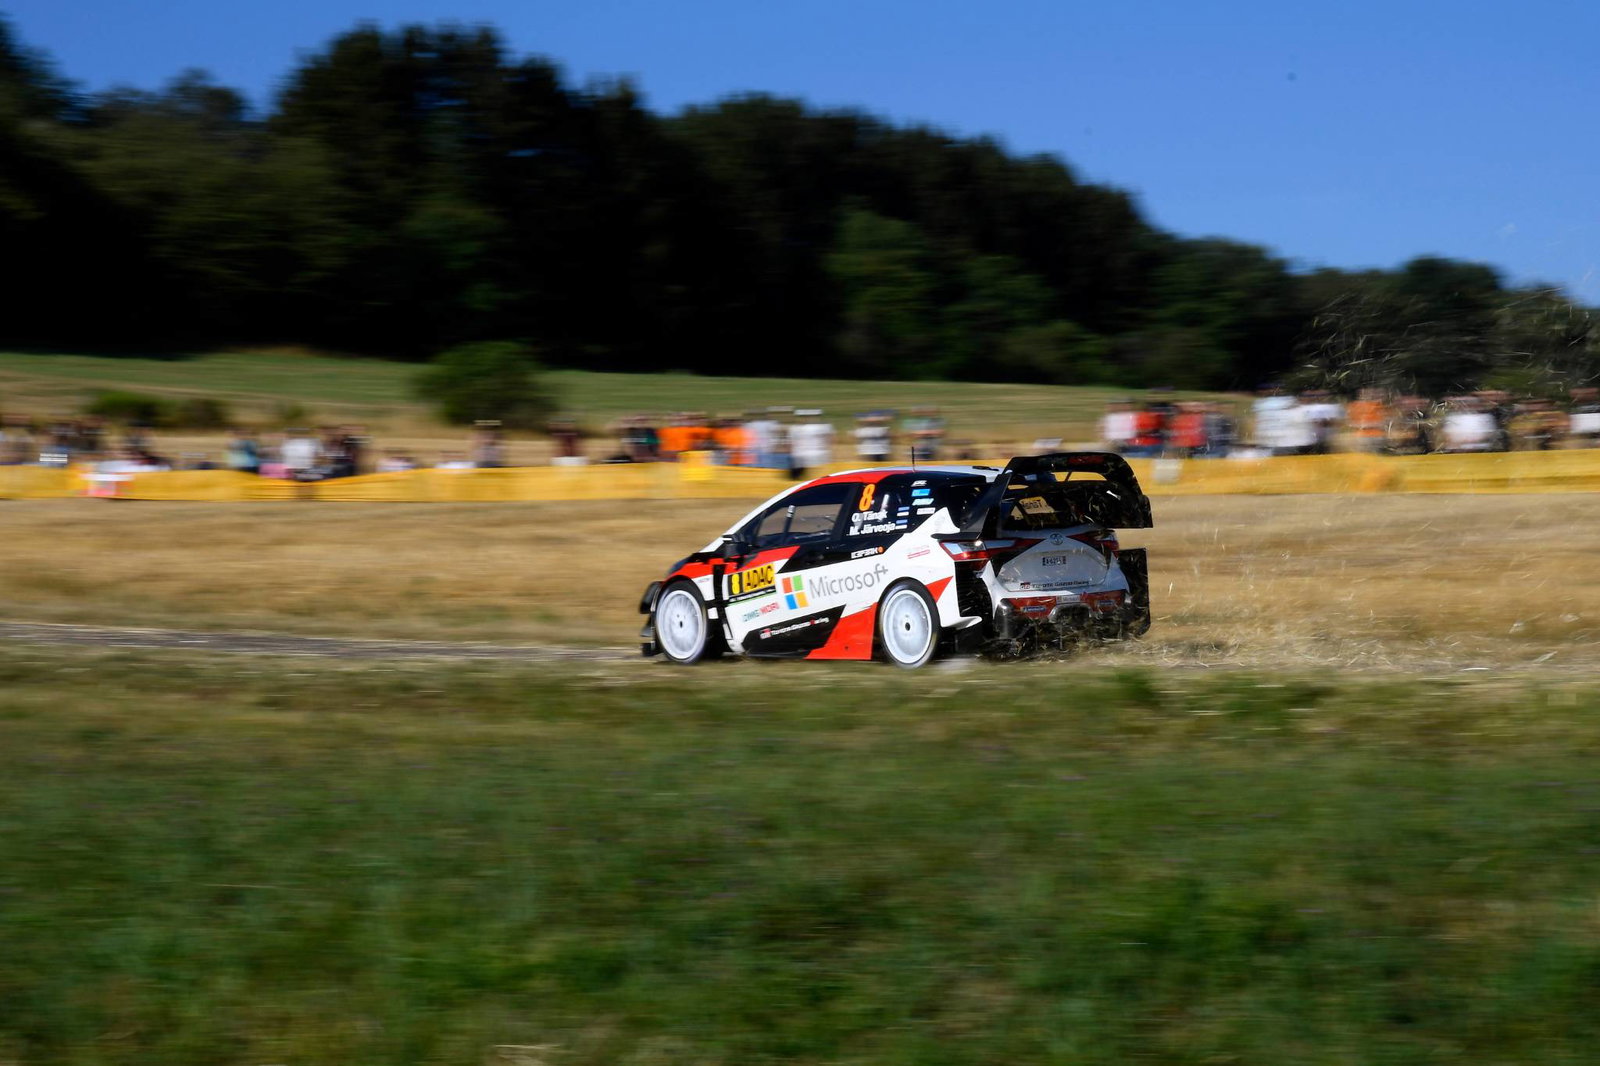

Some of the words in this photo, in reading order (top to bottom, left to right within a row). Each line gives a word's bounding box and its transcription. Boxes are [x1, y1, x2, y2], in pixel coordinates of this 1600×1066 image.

[858, 483, 876, 512] 8
[849, 526, 860, 536] M.
[731, 573, 741, 596] 8
[745, 565, 774, 590] ADAC
[809, 563, 888, 599] Microsoft
